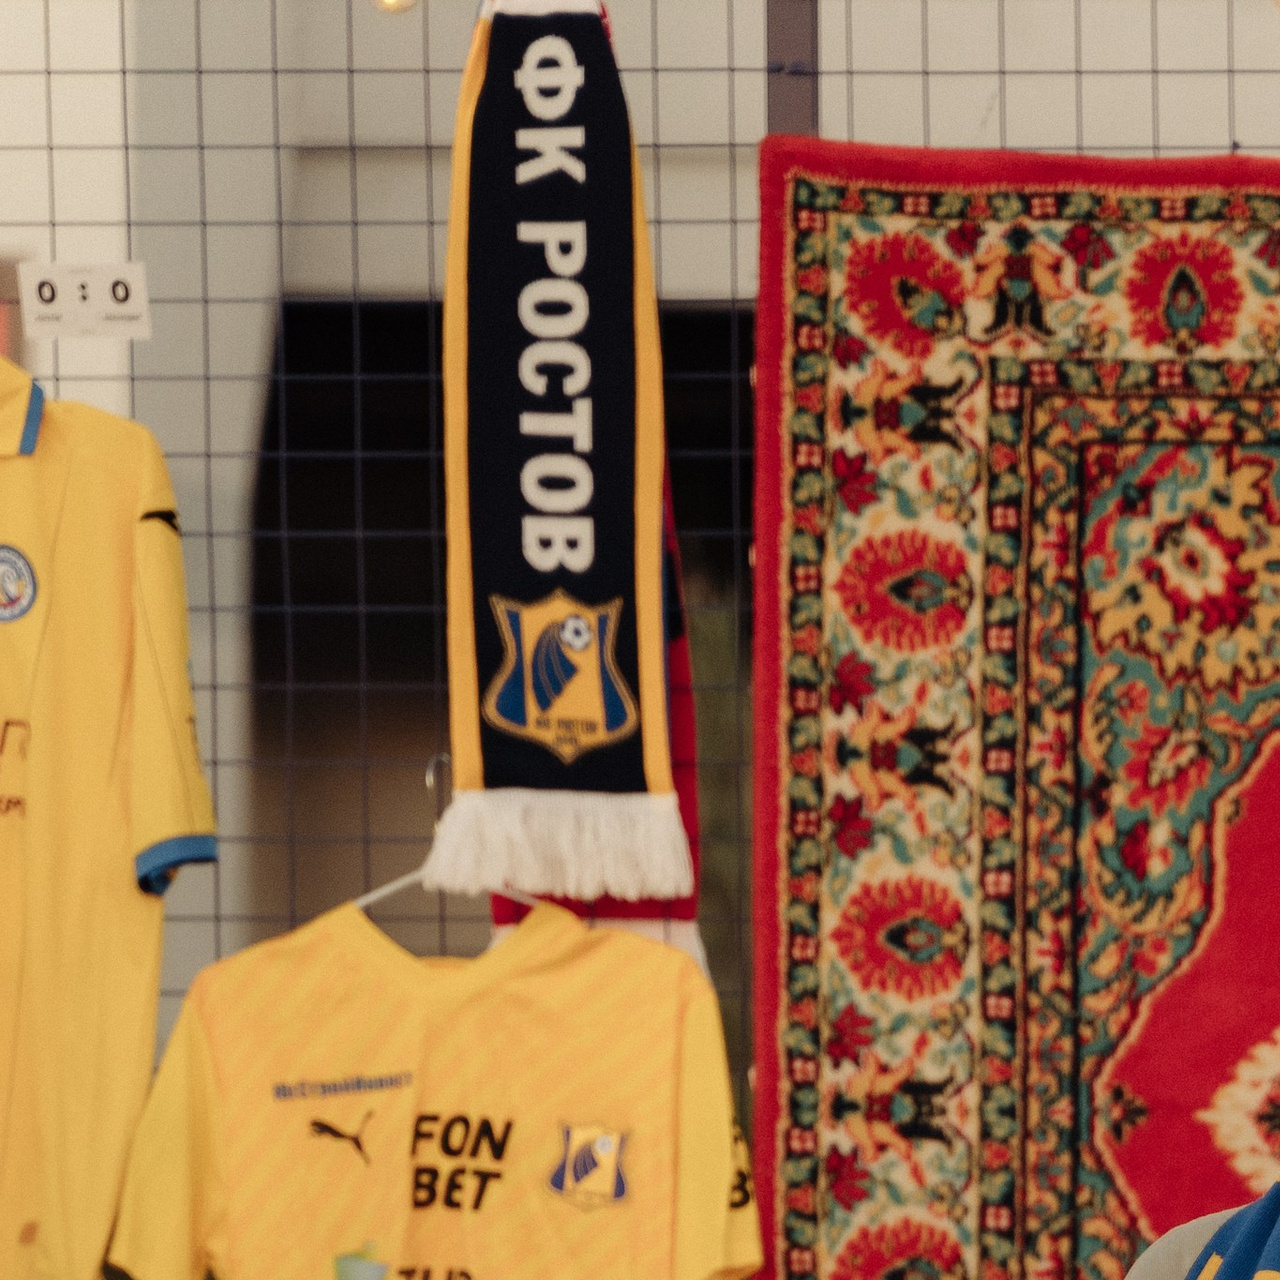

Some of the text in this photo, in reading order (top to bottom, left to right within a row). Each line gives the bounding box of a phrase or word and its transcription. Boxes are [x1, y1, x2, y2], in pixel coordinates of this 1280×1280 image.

[514, 34, 595, 574] ФК РОСТОВ
[411, 1114, 514, 1161] FON
[412, 1166, 503, 1211] BET
